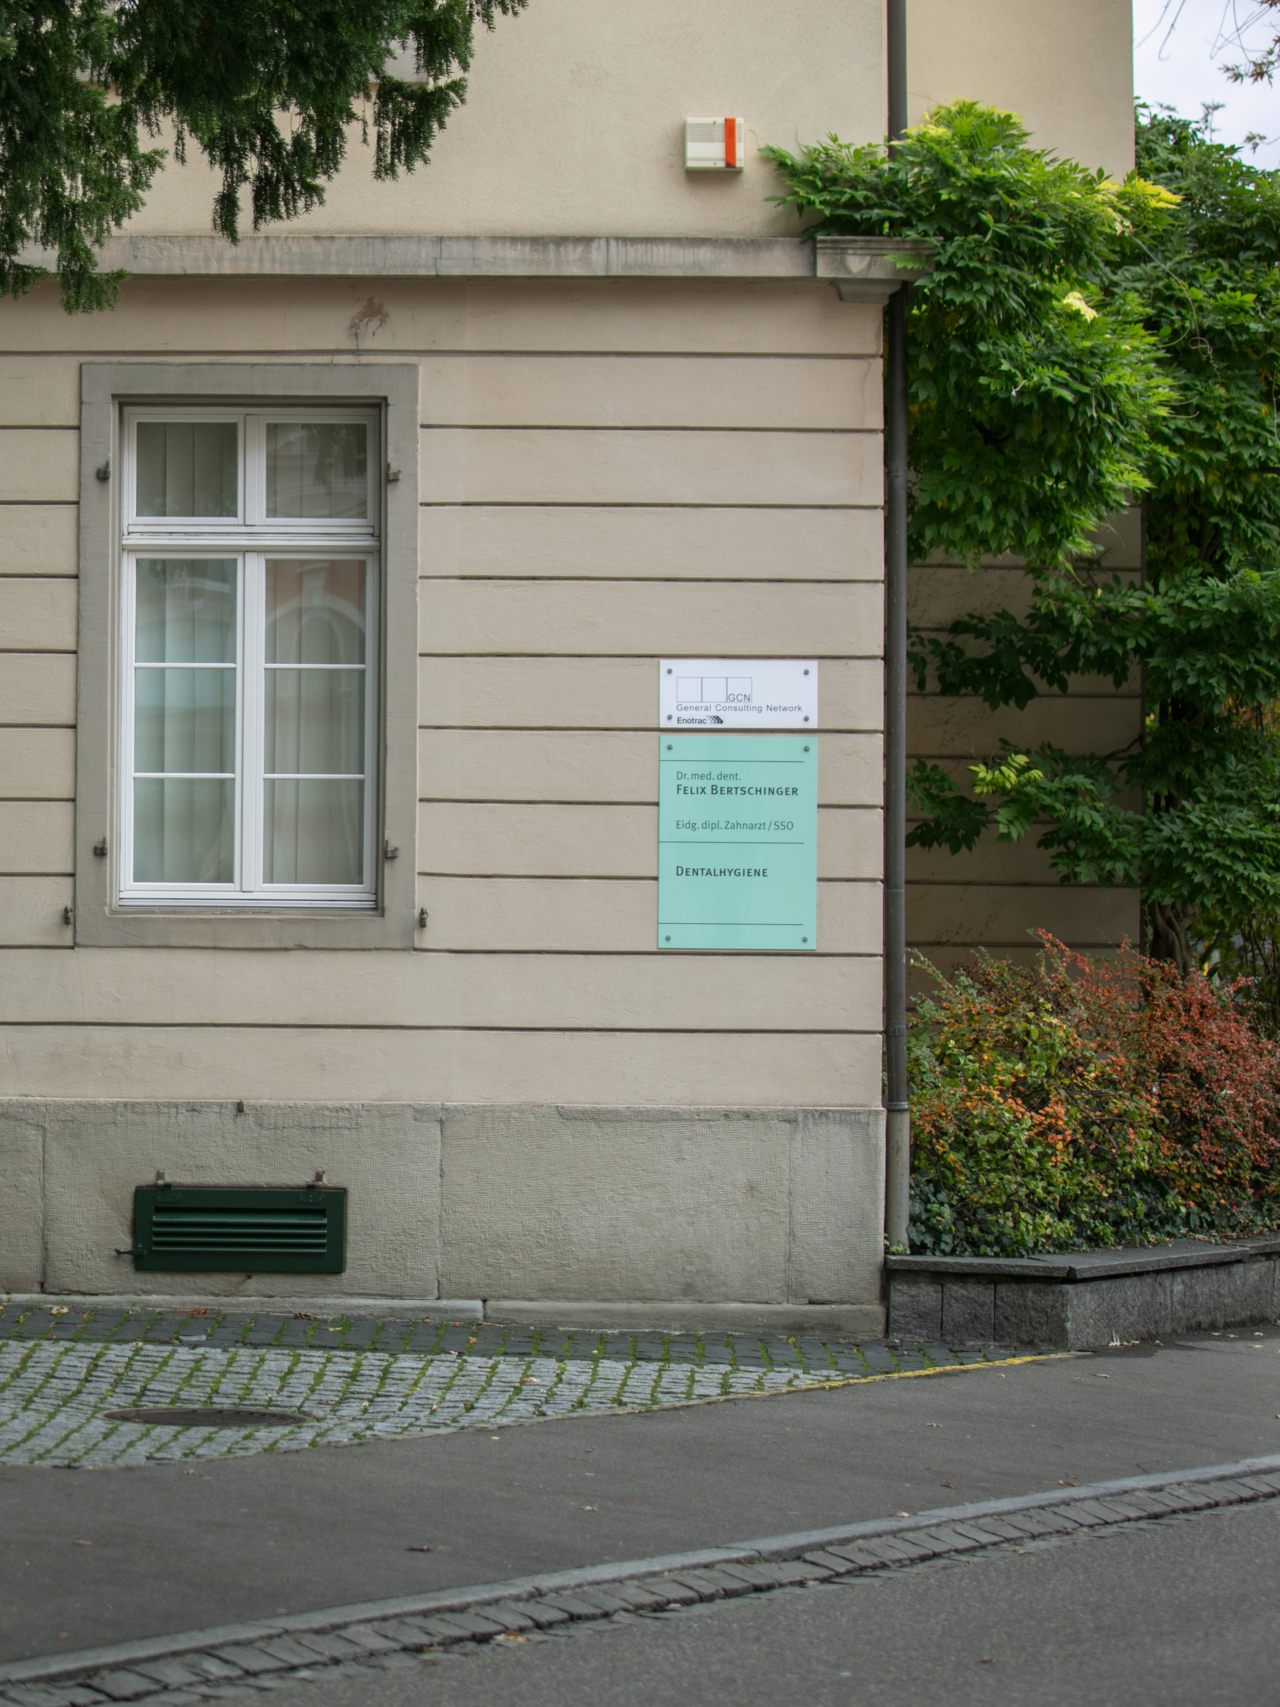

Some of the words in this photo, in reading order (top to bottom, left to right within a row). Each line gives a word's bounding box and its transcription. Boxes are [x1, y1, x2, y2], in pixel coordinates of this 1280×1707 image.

[728, 693, 751, 702] GCN
[676, 703, 712, 712] General
[715, 703, 763, 714] Consulting
[766, 704, 803, 712] Network
[677, 716, 707, 725] Enotrac
[676, 771, 690, 781] Dr.
[690, 771, 715, 781] med.
[716, 771, 742, 781] dent.
[676, 783, 707, 795] FELIX
[710, 784, 799, 796] BERTSCHINGER
[675, 820, 700, 832] Eidg.
[701, 820, 723, 832] dipl.
[724, 820, 766, 831] Zahnarzt
[675, 865, 769, 877] DENTALHYGIENE
